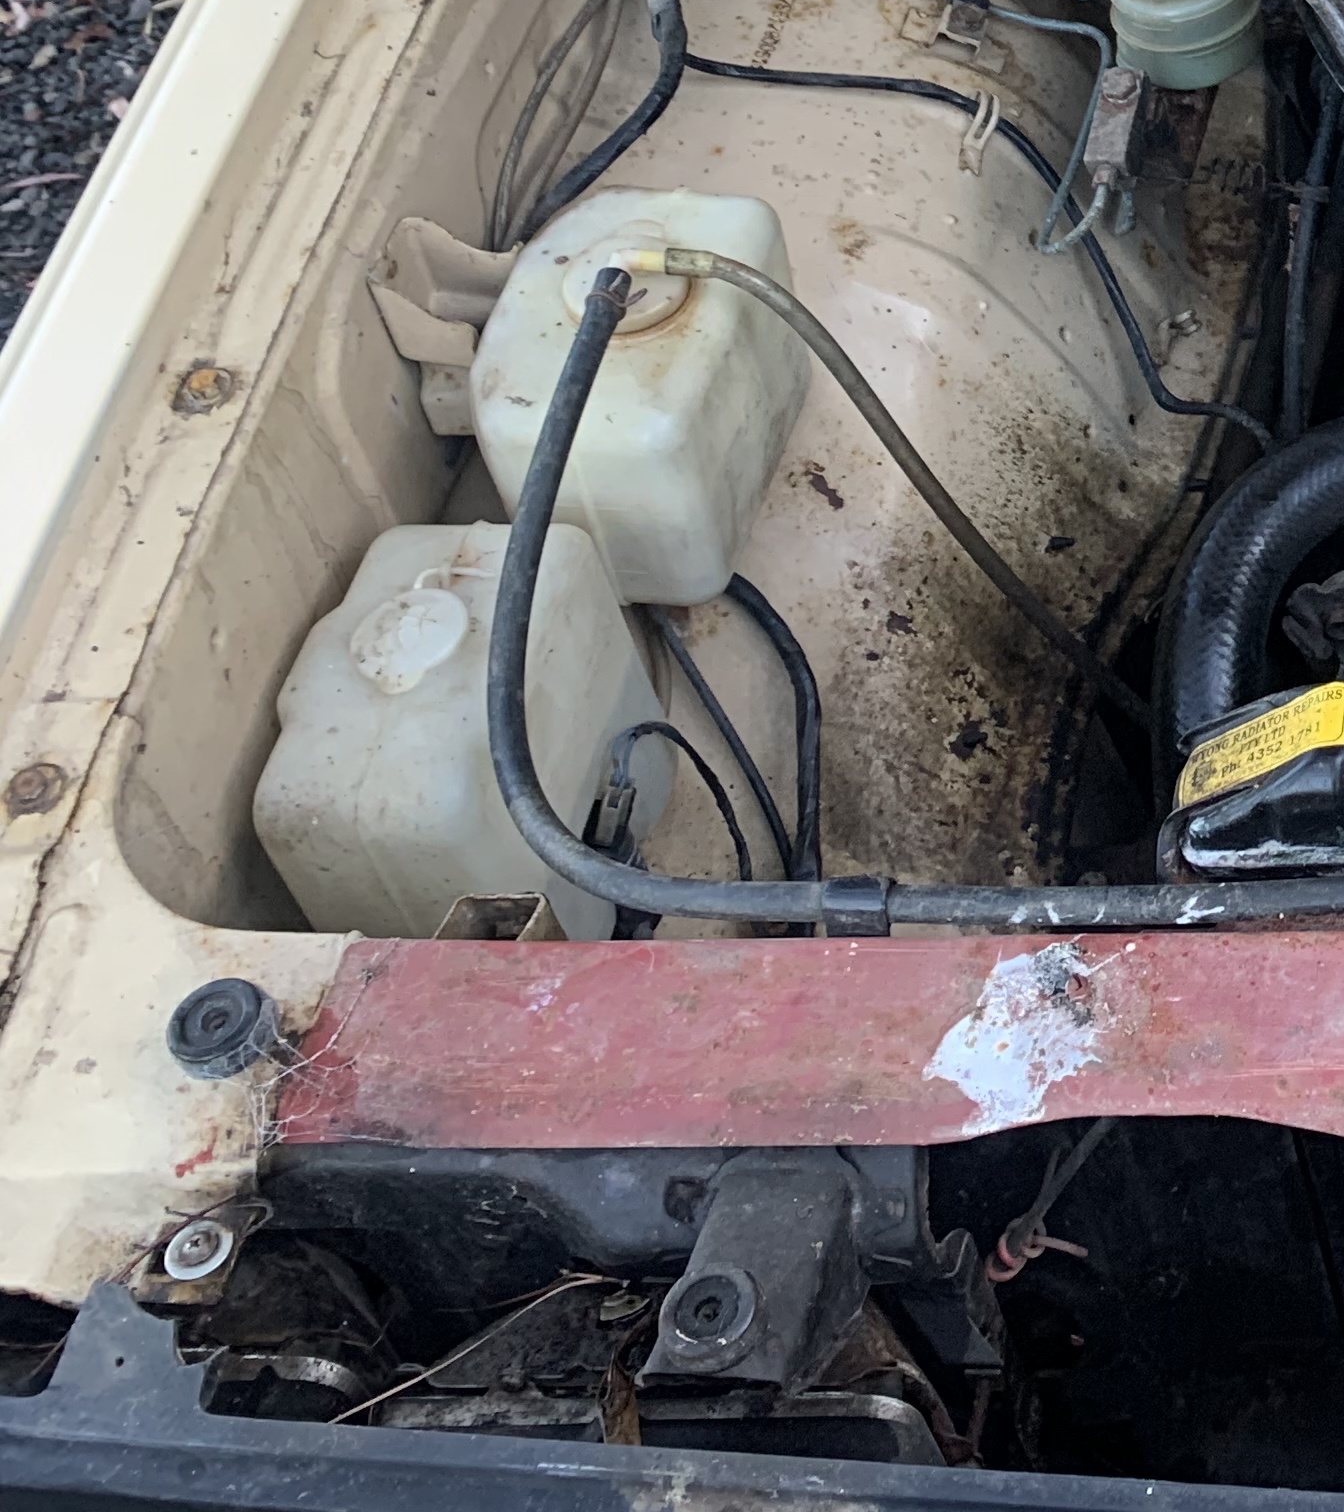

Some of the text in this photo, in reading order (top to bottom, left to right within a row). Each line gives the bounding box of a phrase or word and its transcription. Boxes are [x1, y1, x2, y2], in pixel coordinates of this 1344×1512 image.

[1232, 710, 1290, 746] RADIATOR
[1293, 689, 1343, 716] REPAIRS
[1265, 725, 1286, 743] LTD
[1246, 741, 1283, 762] 4352
[1288, 721, 1320, 746] 1781
